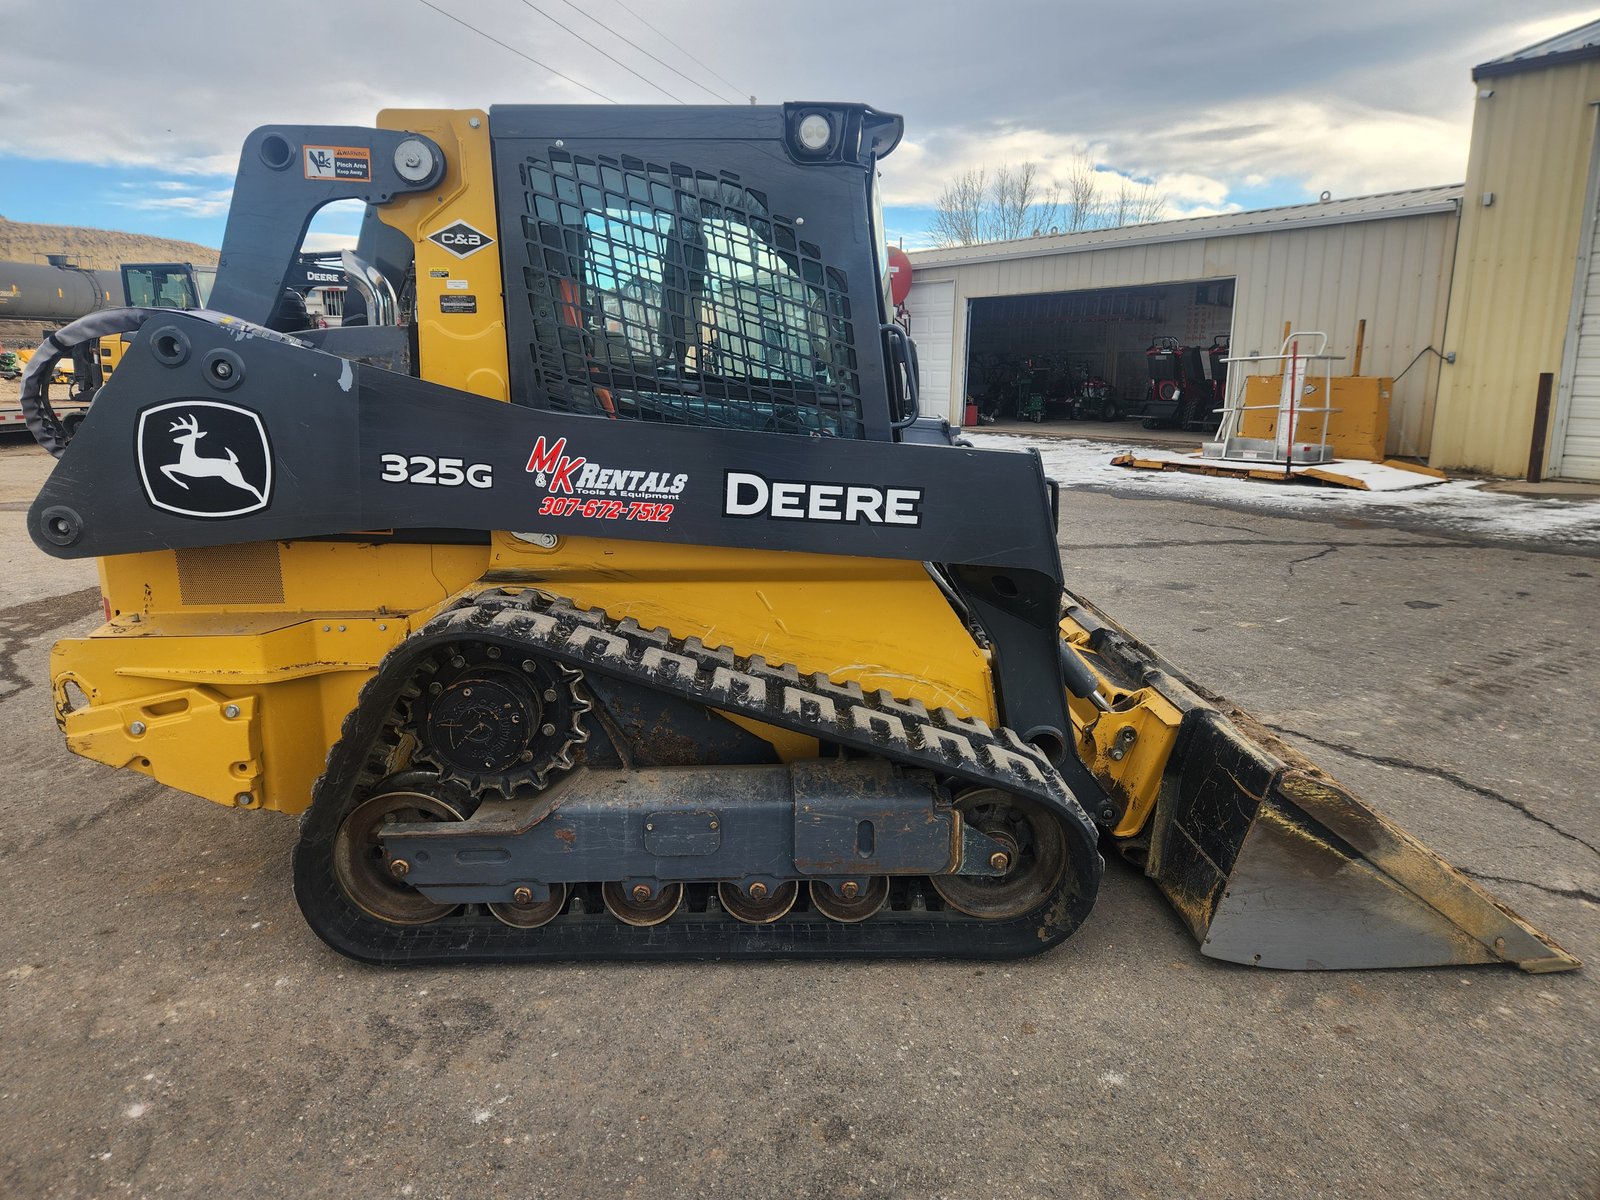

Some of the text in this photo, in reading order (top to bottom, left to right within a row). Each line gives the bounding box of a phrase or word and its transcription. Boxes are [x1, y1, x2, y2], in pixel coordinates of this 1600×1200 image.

[342, 149, 367, 157] WARNING
[441, 233, 481, 245] C&B
[306, 271, 339, 282] DEERE
[381, 454, 492, 488] 325G
[575, 463, 688, 494] RENTALS
[575, 487, 606, 496] Tools
[620, 490, 680, 500] Equipment
[726, 472, 920, 525] DEERE
[538, 496, 674, 522] 307-672-7512
